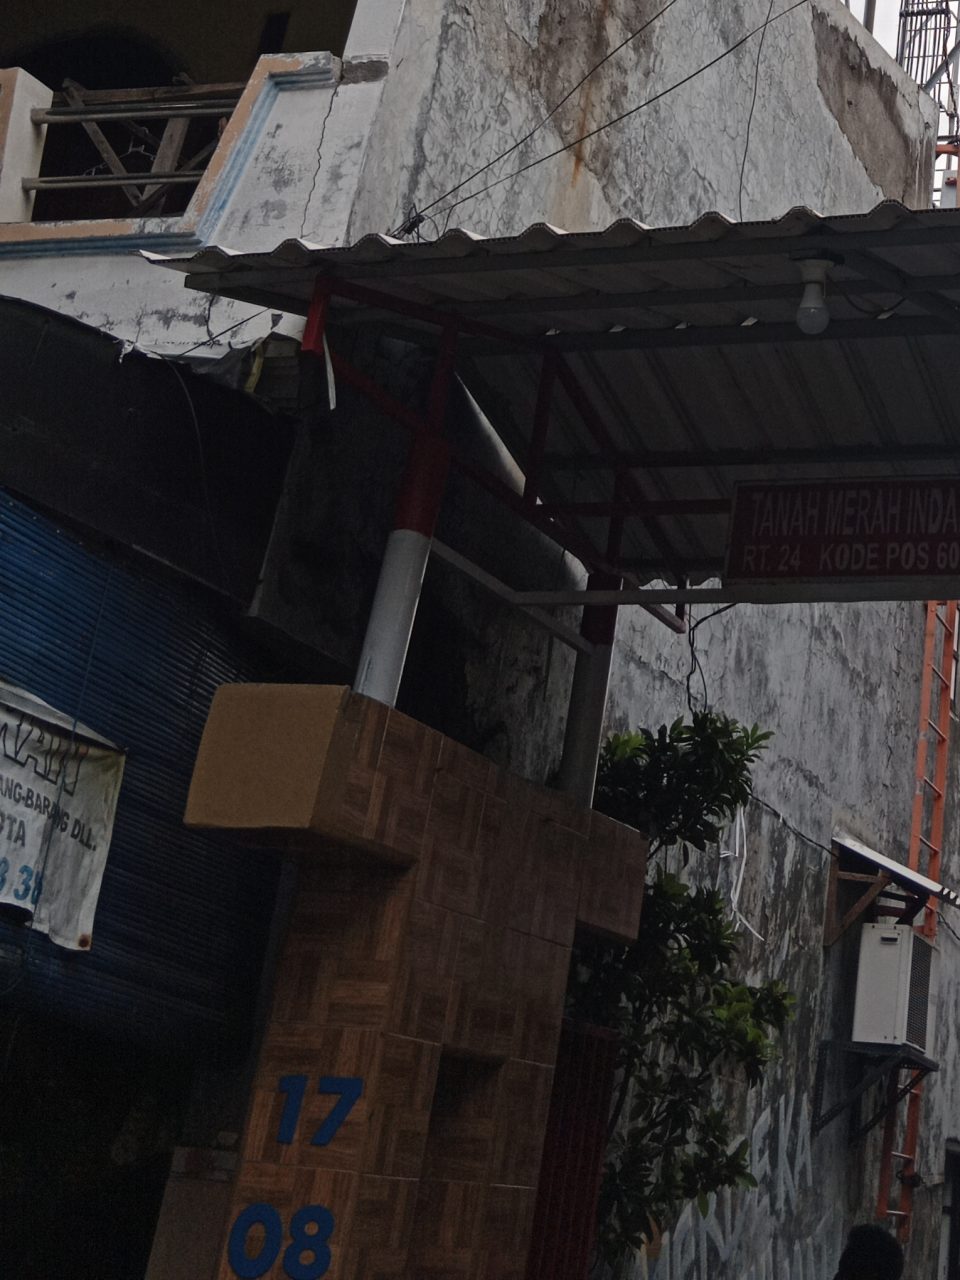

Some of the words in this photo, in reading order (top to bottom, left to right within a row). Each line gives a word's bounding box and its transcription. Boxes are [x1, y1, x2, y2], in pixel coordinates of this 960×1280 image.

[751, 490, 819, 537] TANAH
[825, 489, 900, 536] MERAH
[743, 545, 772, 572] RT.
[779, 545, 802, 571] 24
[819, 542, 878, 571] KODE
[887, 541, 929, 570] POS
[70, 818, 97, 851] DLL.
[277, 1074, 363, 1147] 17
[228, 1202, 336, 1280] 08
